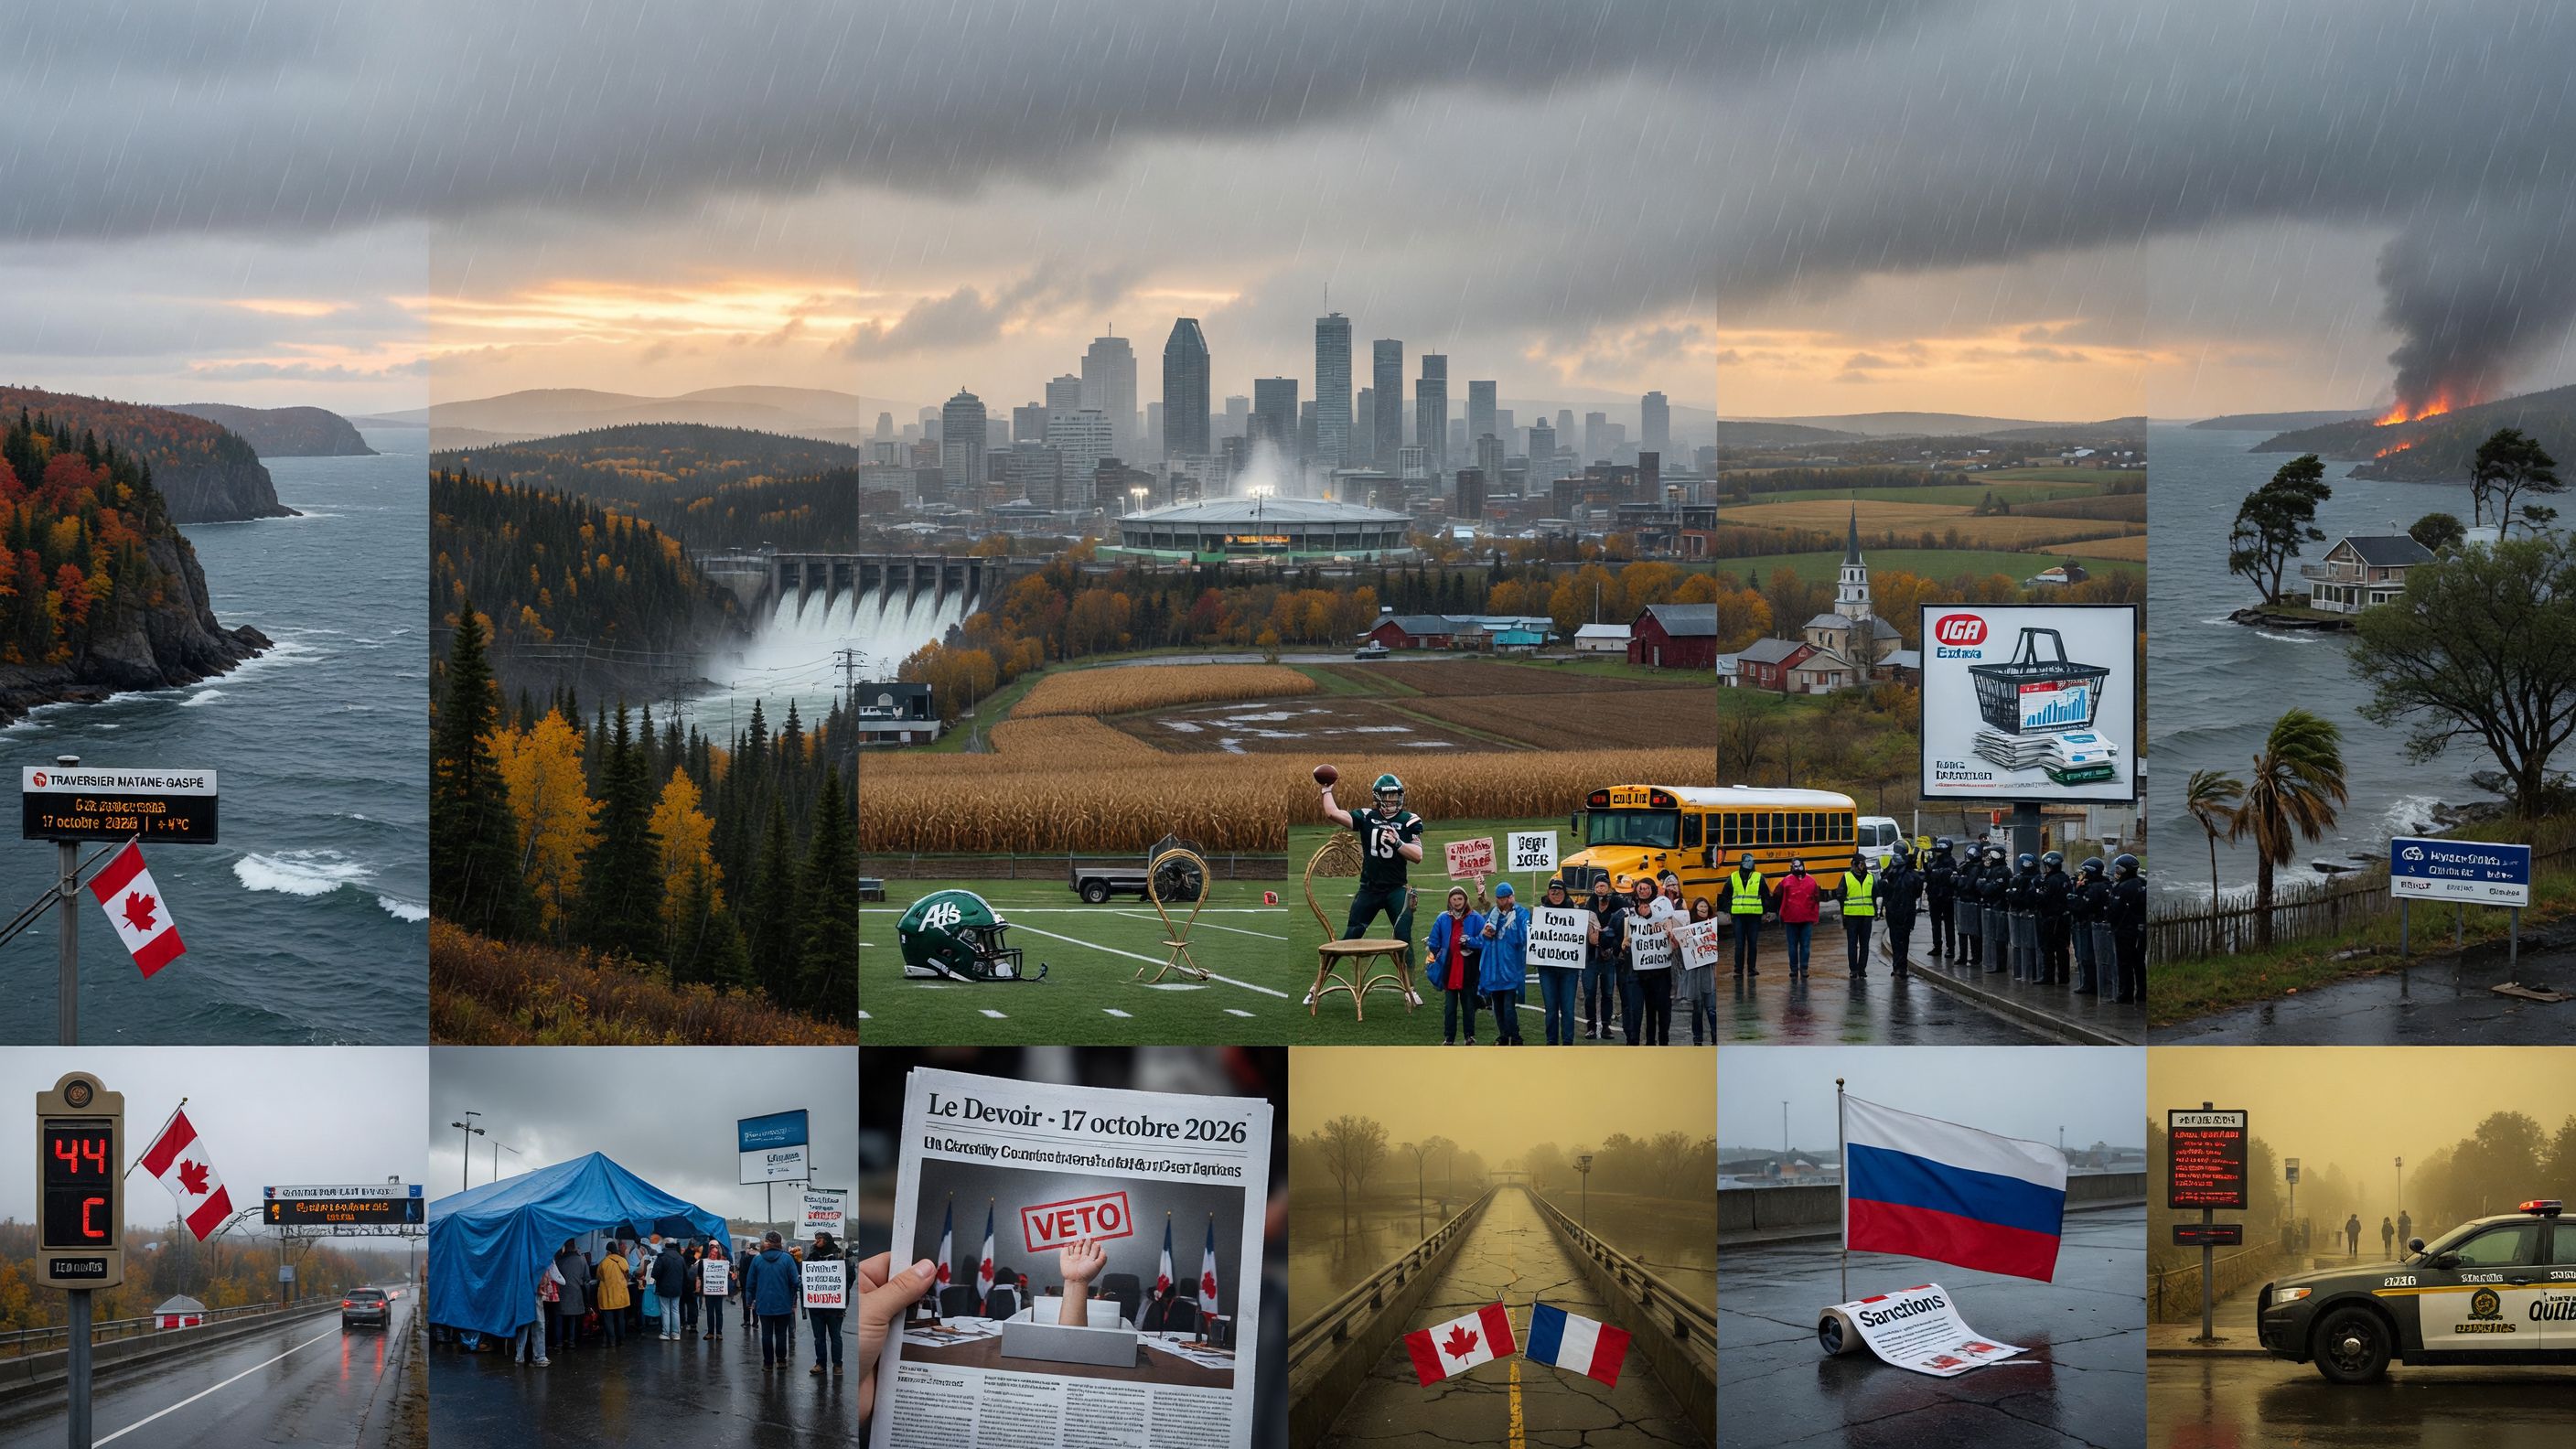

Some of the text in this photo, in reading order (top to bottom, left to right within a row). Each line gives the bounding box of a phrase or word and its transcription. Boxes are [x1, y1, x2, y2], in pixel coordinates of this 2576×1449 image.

[1941, 619, 1982, 640] IGA
[50, 775, 114, 787] TRAVERSIER
[42, 815, 53, 828] 17
[927, 1092, 958, 1118] Le
[962, 1097, 1043, 1127] Devoir
[1061, 1109, 1087, 1132] 17
[1090, 1115, 1180, 1140] octobre
[1184, 1118, 1247, 1143] 2026
[55, 1139, 106, 1175] 44
[82, 1197, 105, 1238] C
[1031, 1202, 1122, 1241] VETO
[1859, 1294, 1946, 1327] Sanctions
